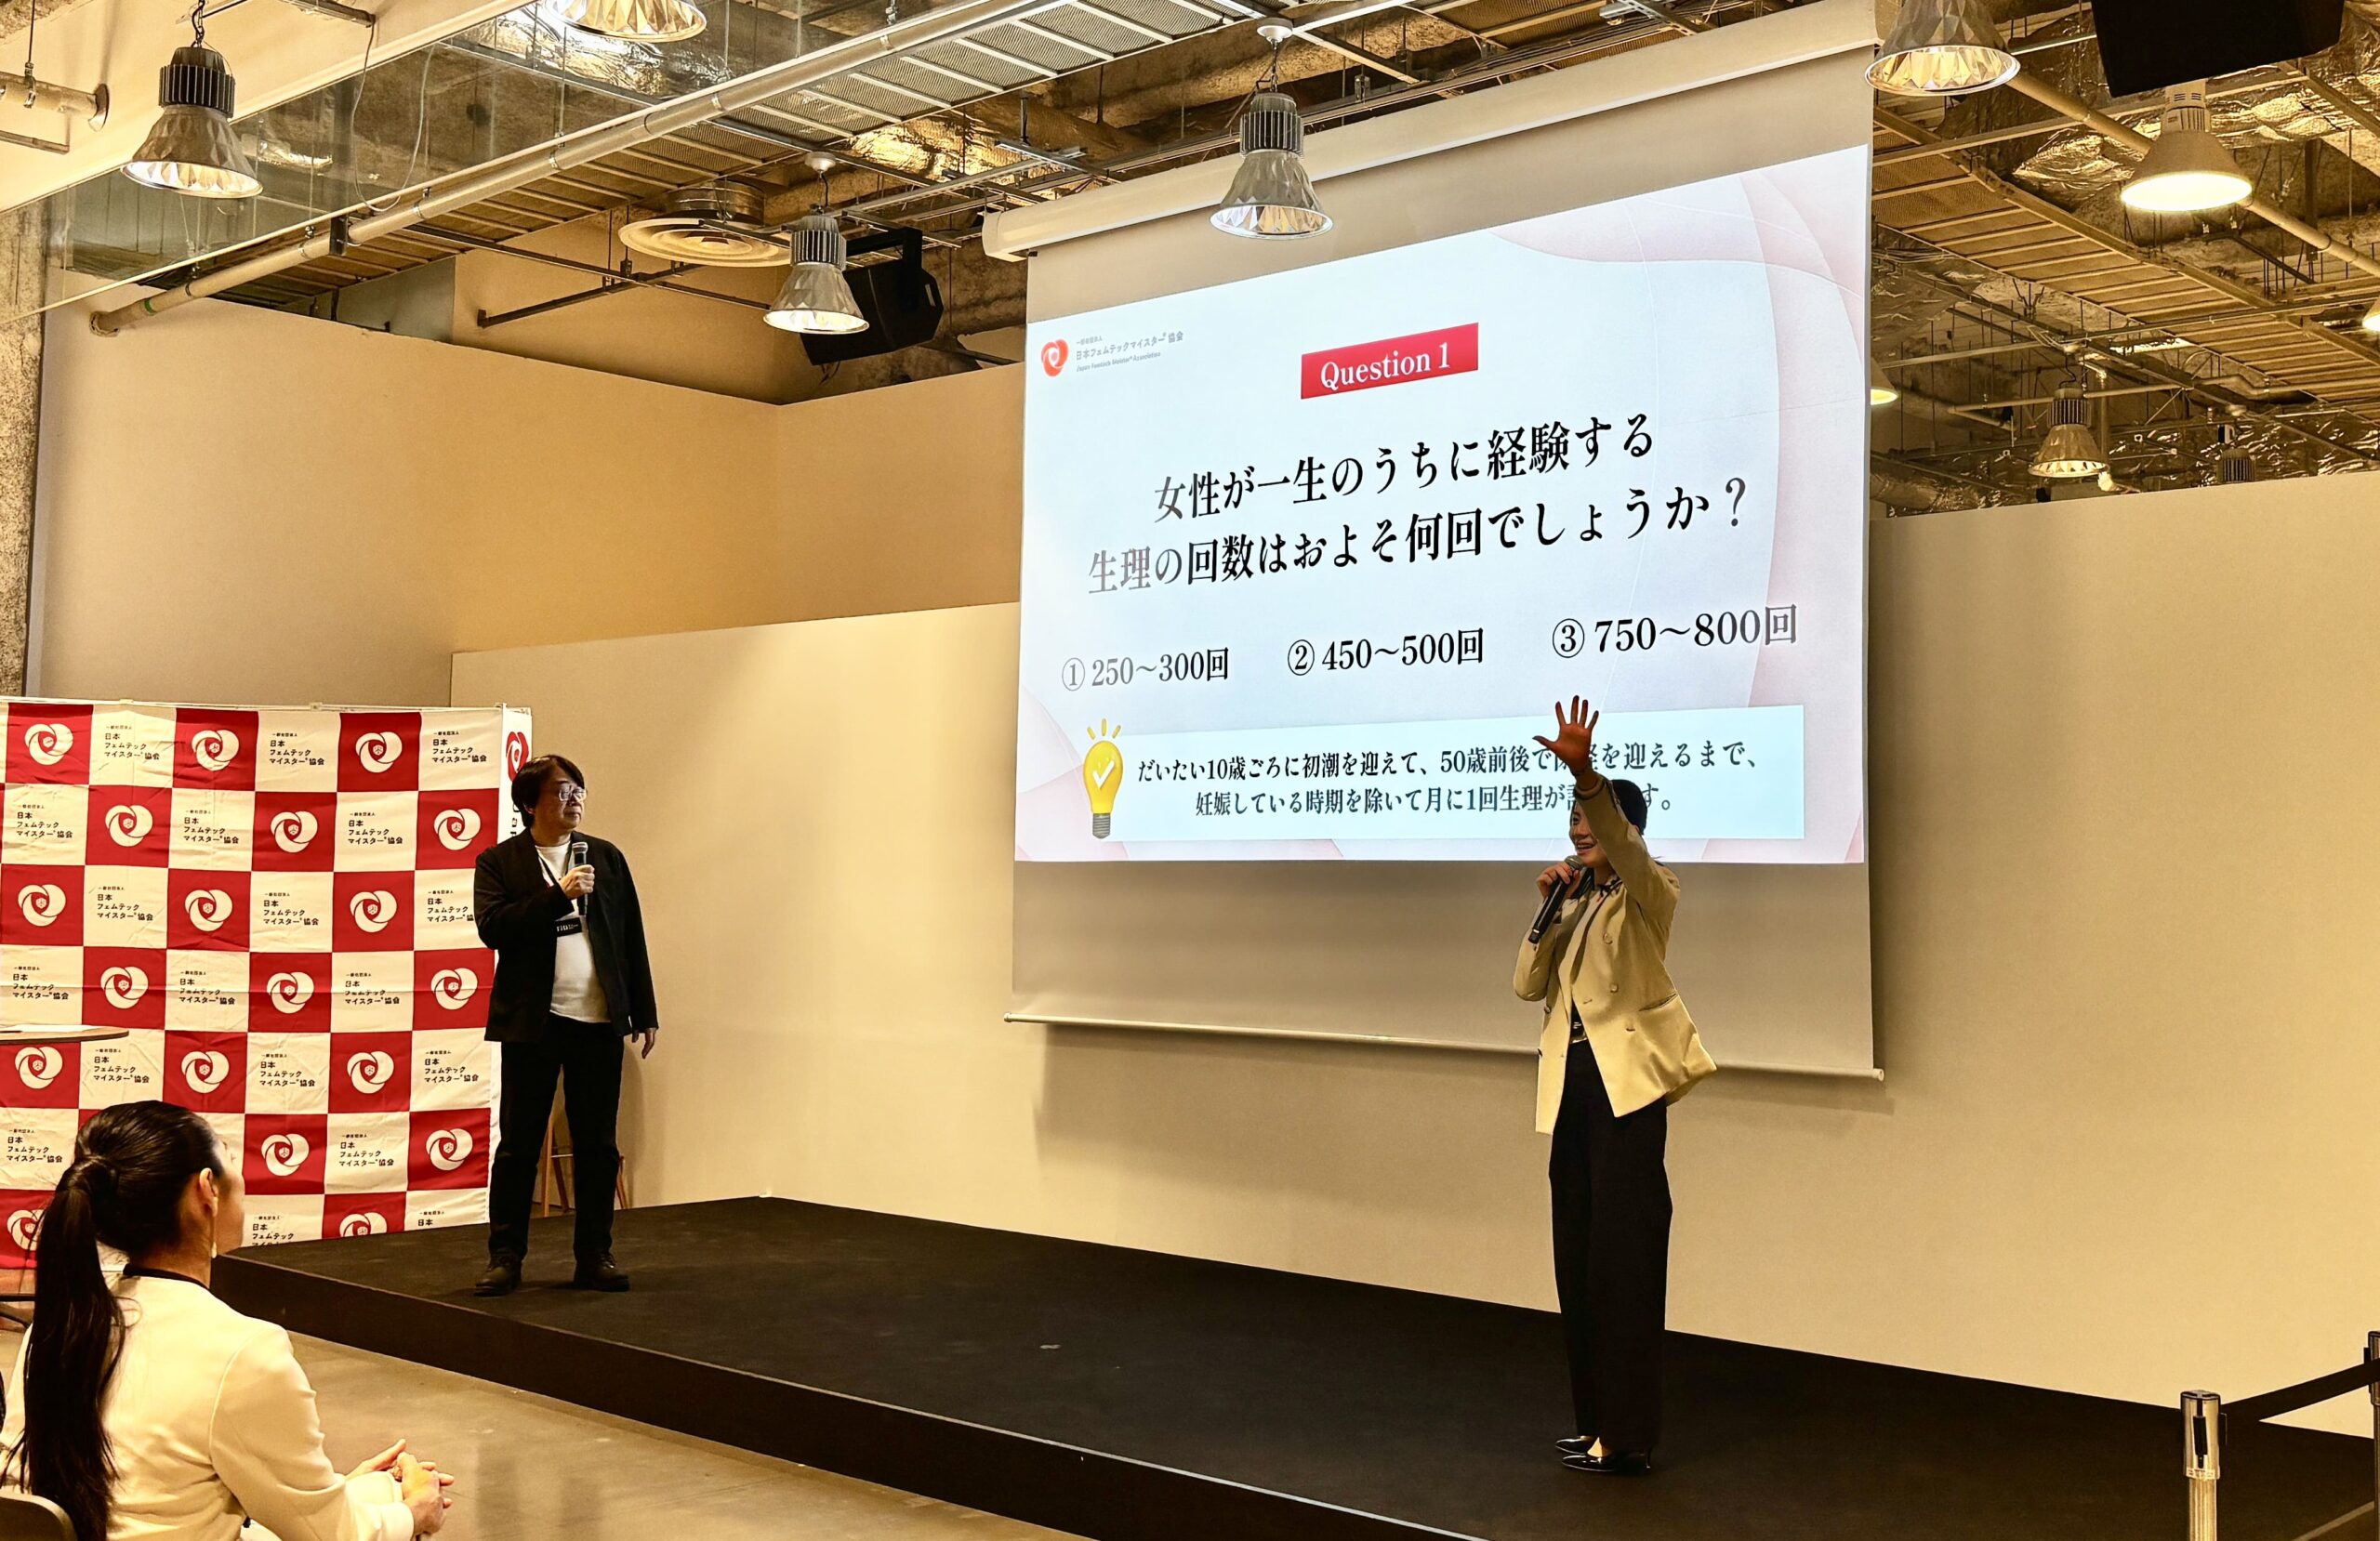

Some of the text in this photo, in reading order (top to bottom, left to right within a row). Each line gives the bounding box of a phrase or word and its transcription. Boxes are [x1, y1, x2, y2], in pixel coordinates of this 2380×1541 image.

[1320, 342, 1452, 391] Question 1
[1155, 413, 1653, 523] 女性が一生のうちに経験する
[1089, 477, 1747, 594] 生理の回数はおよそ何回でしょうか？
[104, 732, 119, 741] 日本
[270, 739, 285, 748] 日本
[432, 738, 448, 746] 日本
[1138, 741, 1756, 783] だいたい10歳ごろに初潮を迎えて、50歳前後でを迎えるまで、
[1196, 784, 1671, 816] 妊娠している時期を除いて月に1回生理がす。
[17, 811, 33, 820] 日本
[184, 816, 199, 825] 日本
[348, 819, 364, 827] 日本
[97, 893, 112, 902] 日本
[427, 897, 443, 905] 日本
[263, 899, 279, 908] 日本
[12, 973, 29, 981] 日本
[179, 978, 195, 986] 日本
[345, 980, 361, 988] 日本
[93, 1056, 110, 1064] 日本
[260, 1060, 276, 1069] 日本
[424, 1058, 440, 1066] 日本
[7, 1136, 23, 1144] 日本
[339, 1141, 356, 1150] 日本
[252, 1223, 269, 1231] 日本
[417, 1218, 434, 1227] 日本
